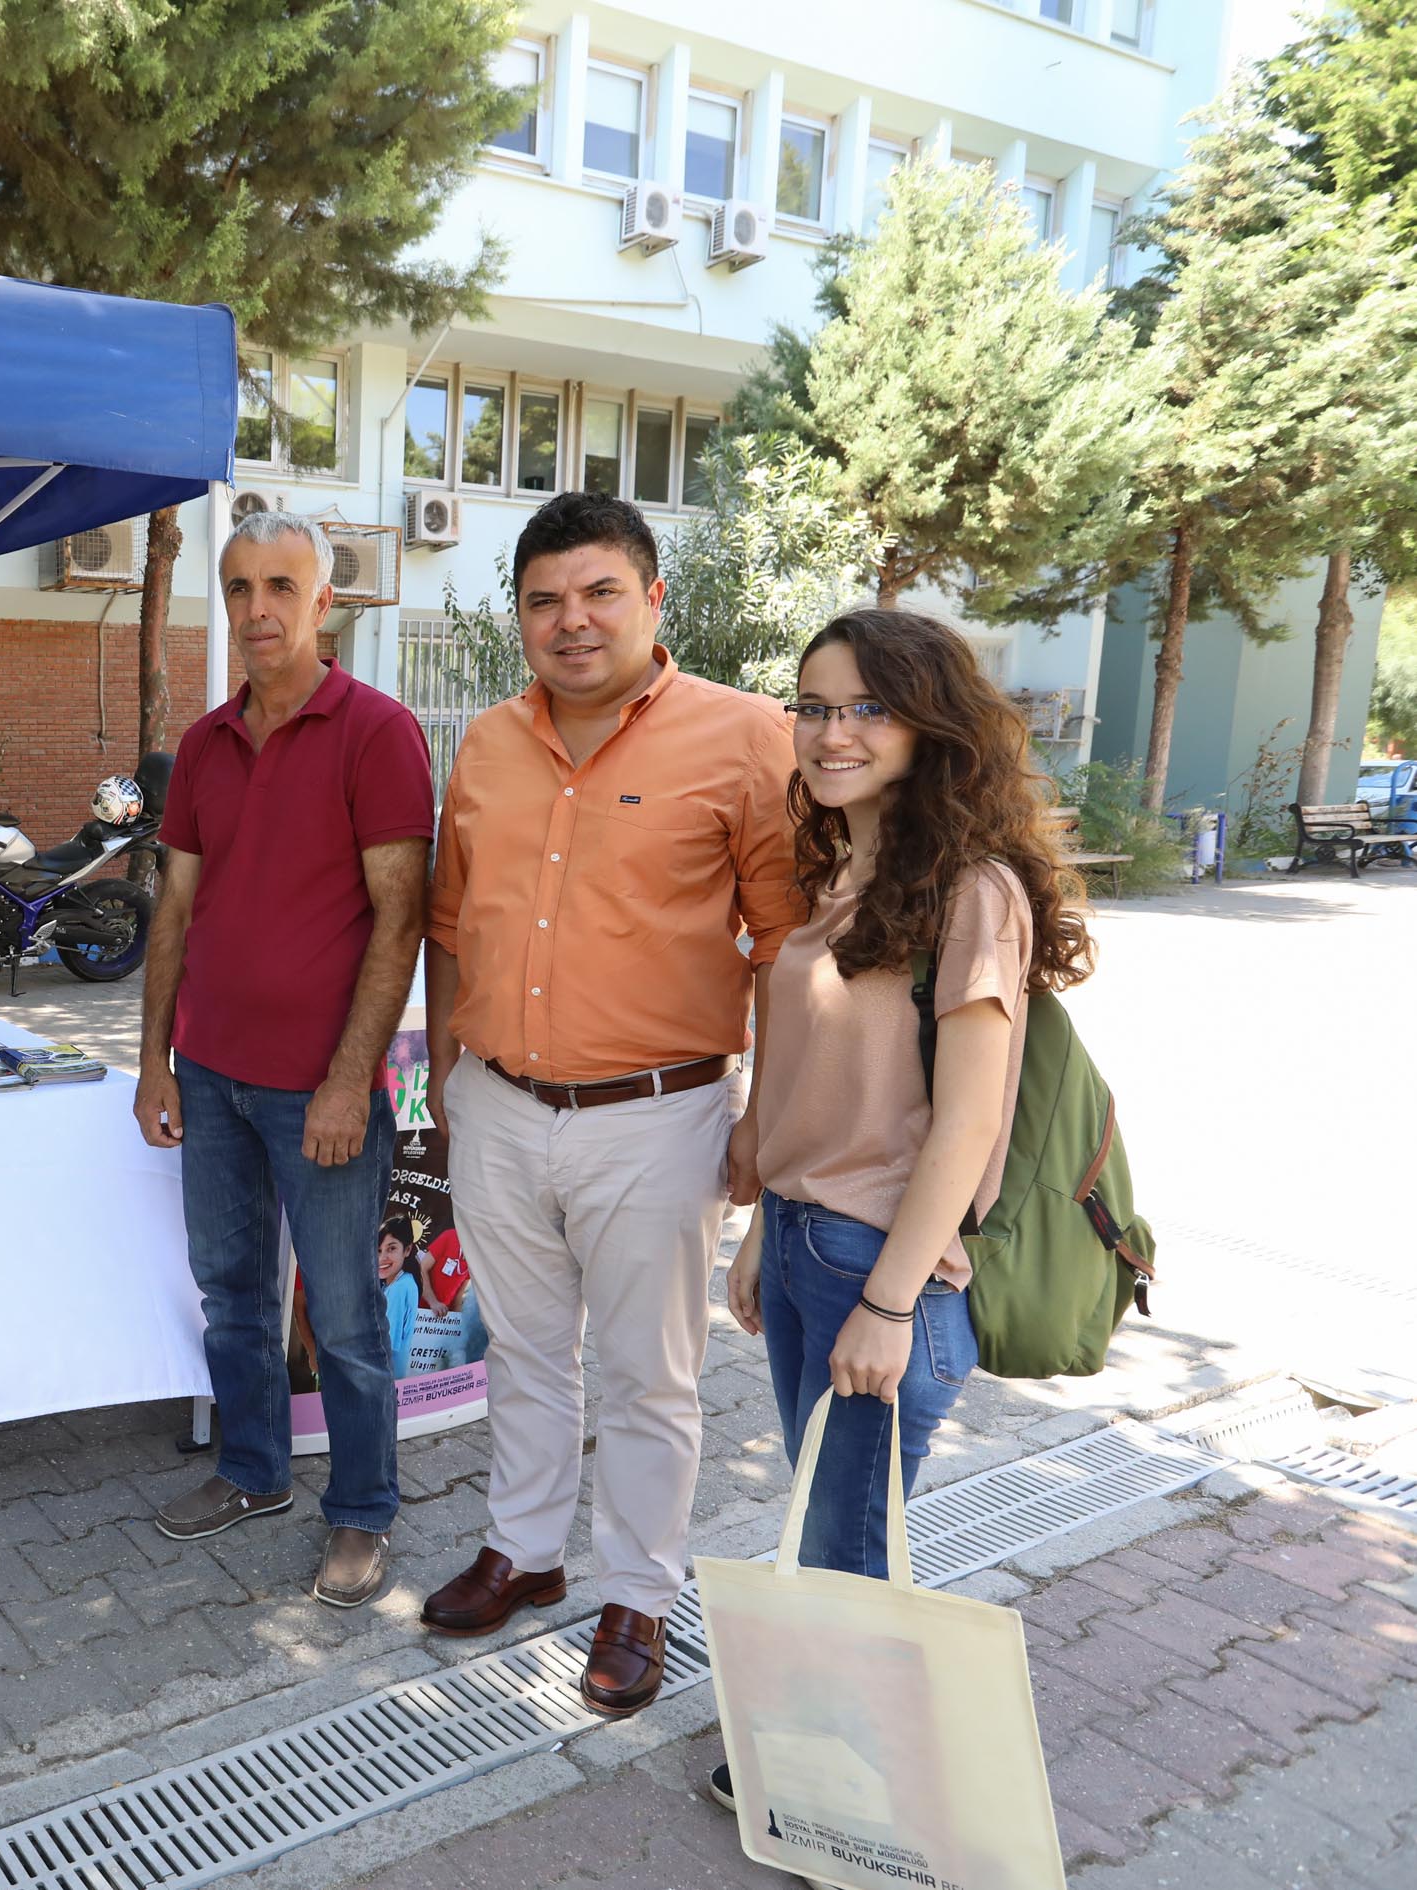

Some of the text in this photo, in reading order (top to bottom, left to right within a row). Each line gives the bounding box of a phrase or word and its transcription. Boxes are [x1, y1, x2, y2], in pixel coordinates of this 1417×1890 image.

[390, 1168, 451, 1194] OŞGELDİ
[389, 1189, 421, 1209] ASI
[413, 1326, 423, 1335] yıt
[410, 1346, 448, 1359] CRETSİZ
[410, 1360, 437, 1371] Ulaşım
[425, 1381, 475, 1401] BÜYÜKŞEHİR
[476, 1377, 489, 1388] BEL
[782, 1813, 810, 1826] SOSYAL
[811, 1822, 846, 1838] PROJELER
[784, 1820, 929, 1868] SOSYAL PROJELER ŞUBE MÜDÜRLÜĞÜ
[831, 1845, 936, 1889] BÜYÜKŞEHİR
